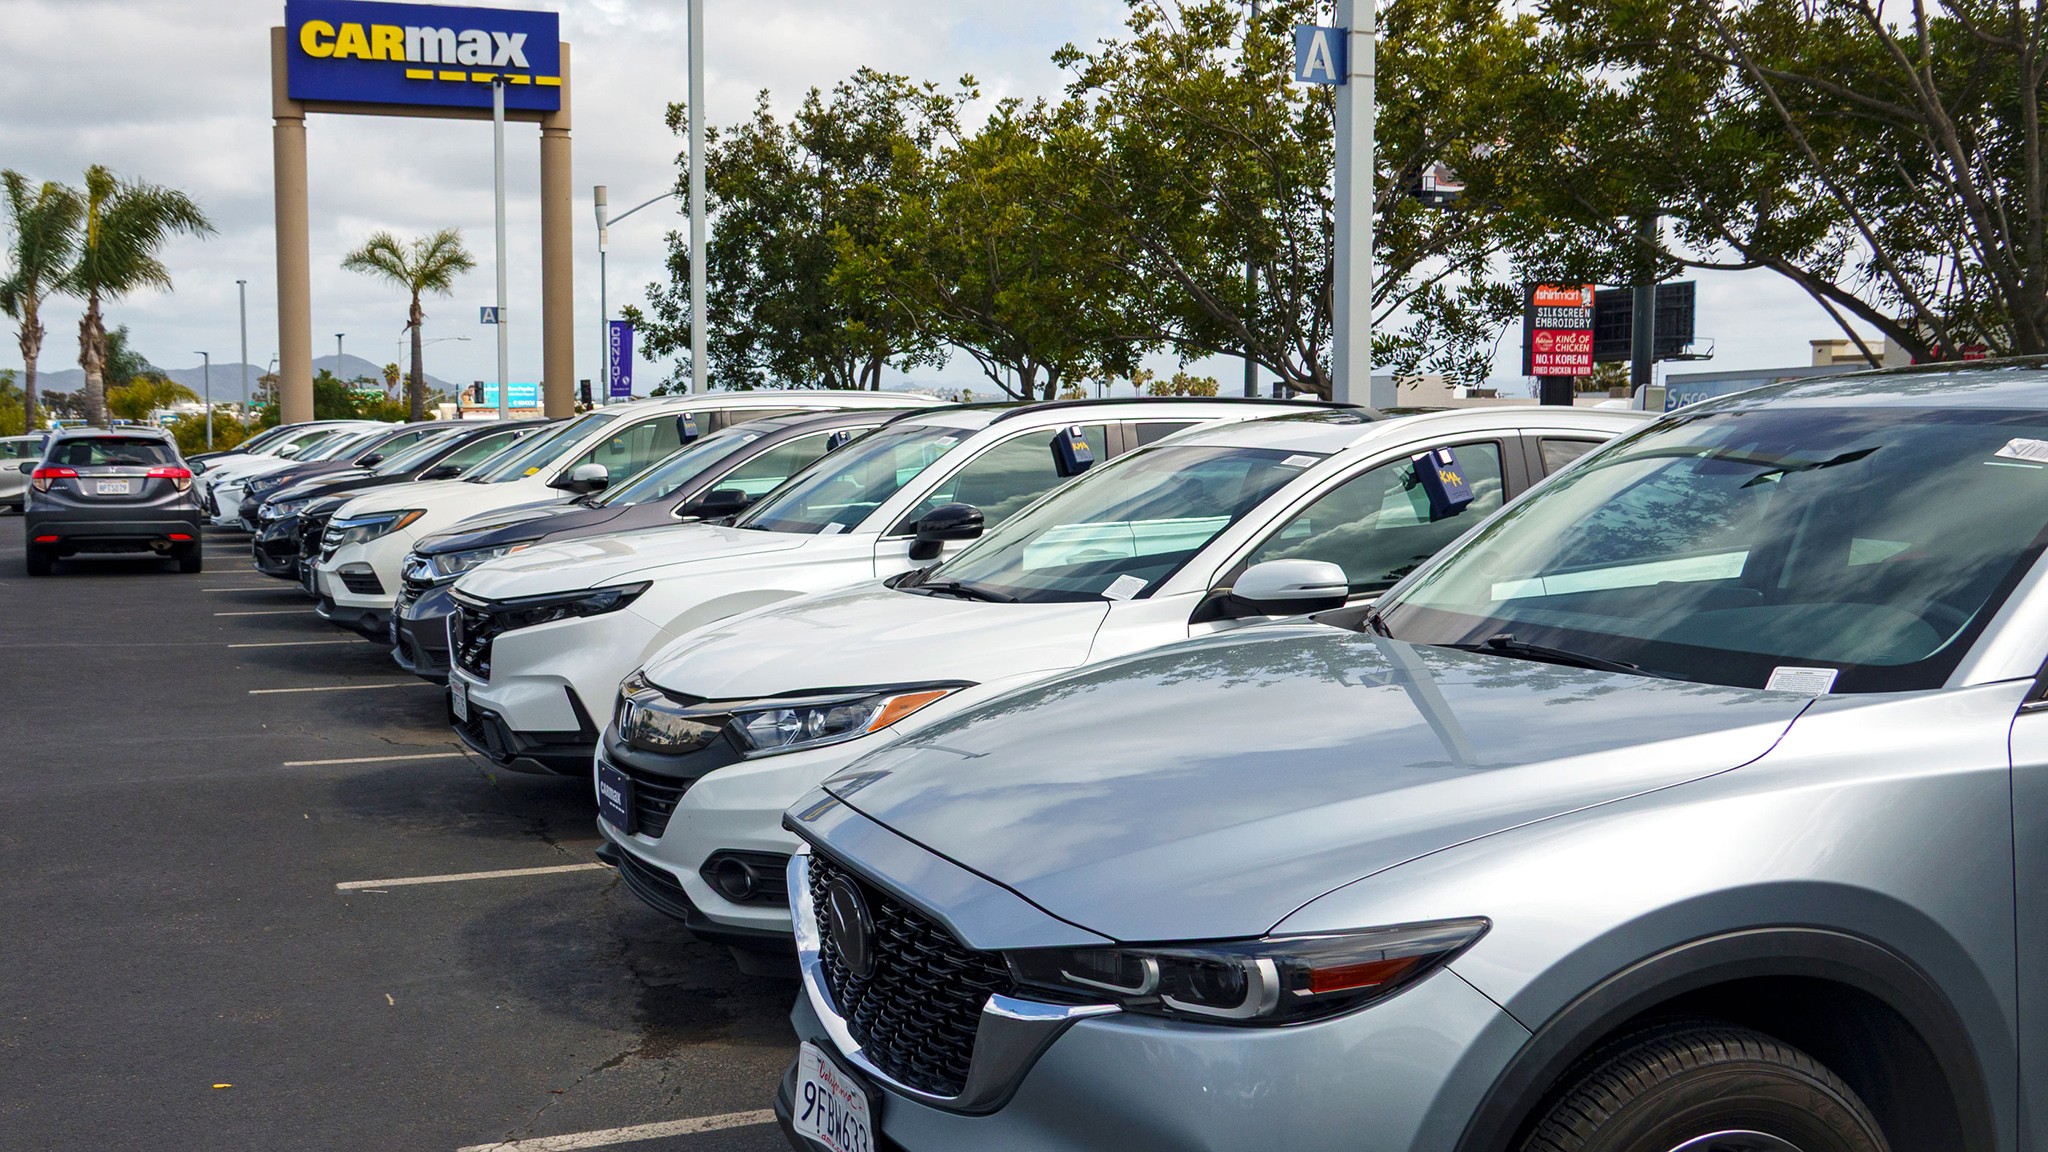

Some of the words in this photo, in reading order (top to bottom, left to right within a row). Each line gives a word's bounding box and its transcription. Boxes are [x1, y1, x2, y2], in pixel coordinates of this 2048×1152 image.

[1302, 30, 1337, 80] A
[482, 306, 497, 323] A
[1537, 307, 1591, 318] SILKSCREEN
[1535, 317, 1592, 328] EMBROIDERY
[1556, 333, 1577, 344] KING
[1578, 335, 1590, 344] OF
[1555, 344, 1590, 352] CHICKEN
[611, 326, 621, 386] CONVOY
[1535, 354, 1554, 365] NO.1
[1555, 354, 1589, 365] KOREAN
[1533, 366, 1549, 375] FRIED
[1549, 366, 1572, 375] CHICKEN
[1578, 366, 1591, 376] BEER
[820, 1060, 856, 1109] California
[801, 1080, 868, 1152] 9FBW633
